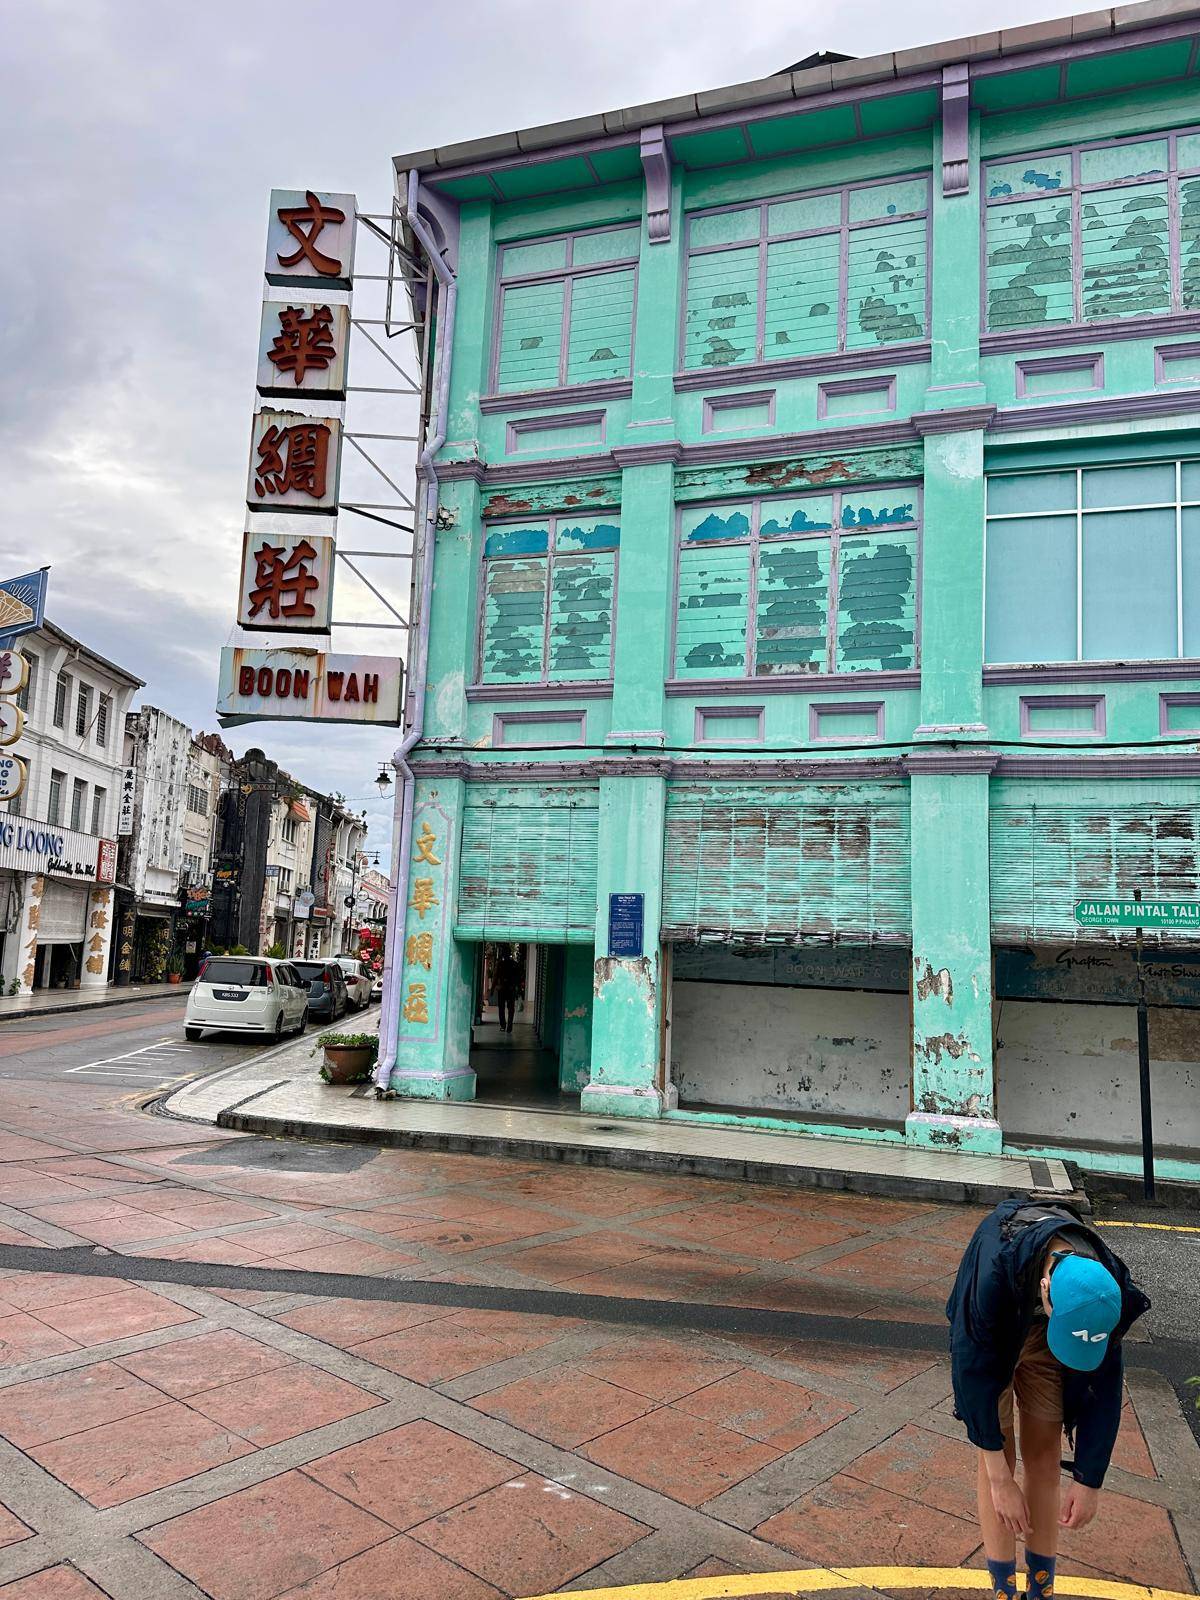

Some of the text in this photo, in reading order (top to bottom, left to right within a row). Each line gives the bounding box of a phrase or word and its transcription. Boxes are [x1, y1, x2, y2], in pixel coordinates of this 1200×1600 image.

[238, 665, 379, 703] BOON WAH
[16, 825, 64, 858] LOONG
[1081, 904, 1199, 918] JALAN PINTAL TALI
[1056, 949, 1114, 969] Grafton
[785, 963, 825, 975] BOON
[831, 965, 865, 977] WAH
